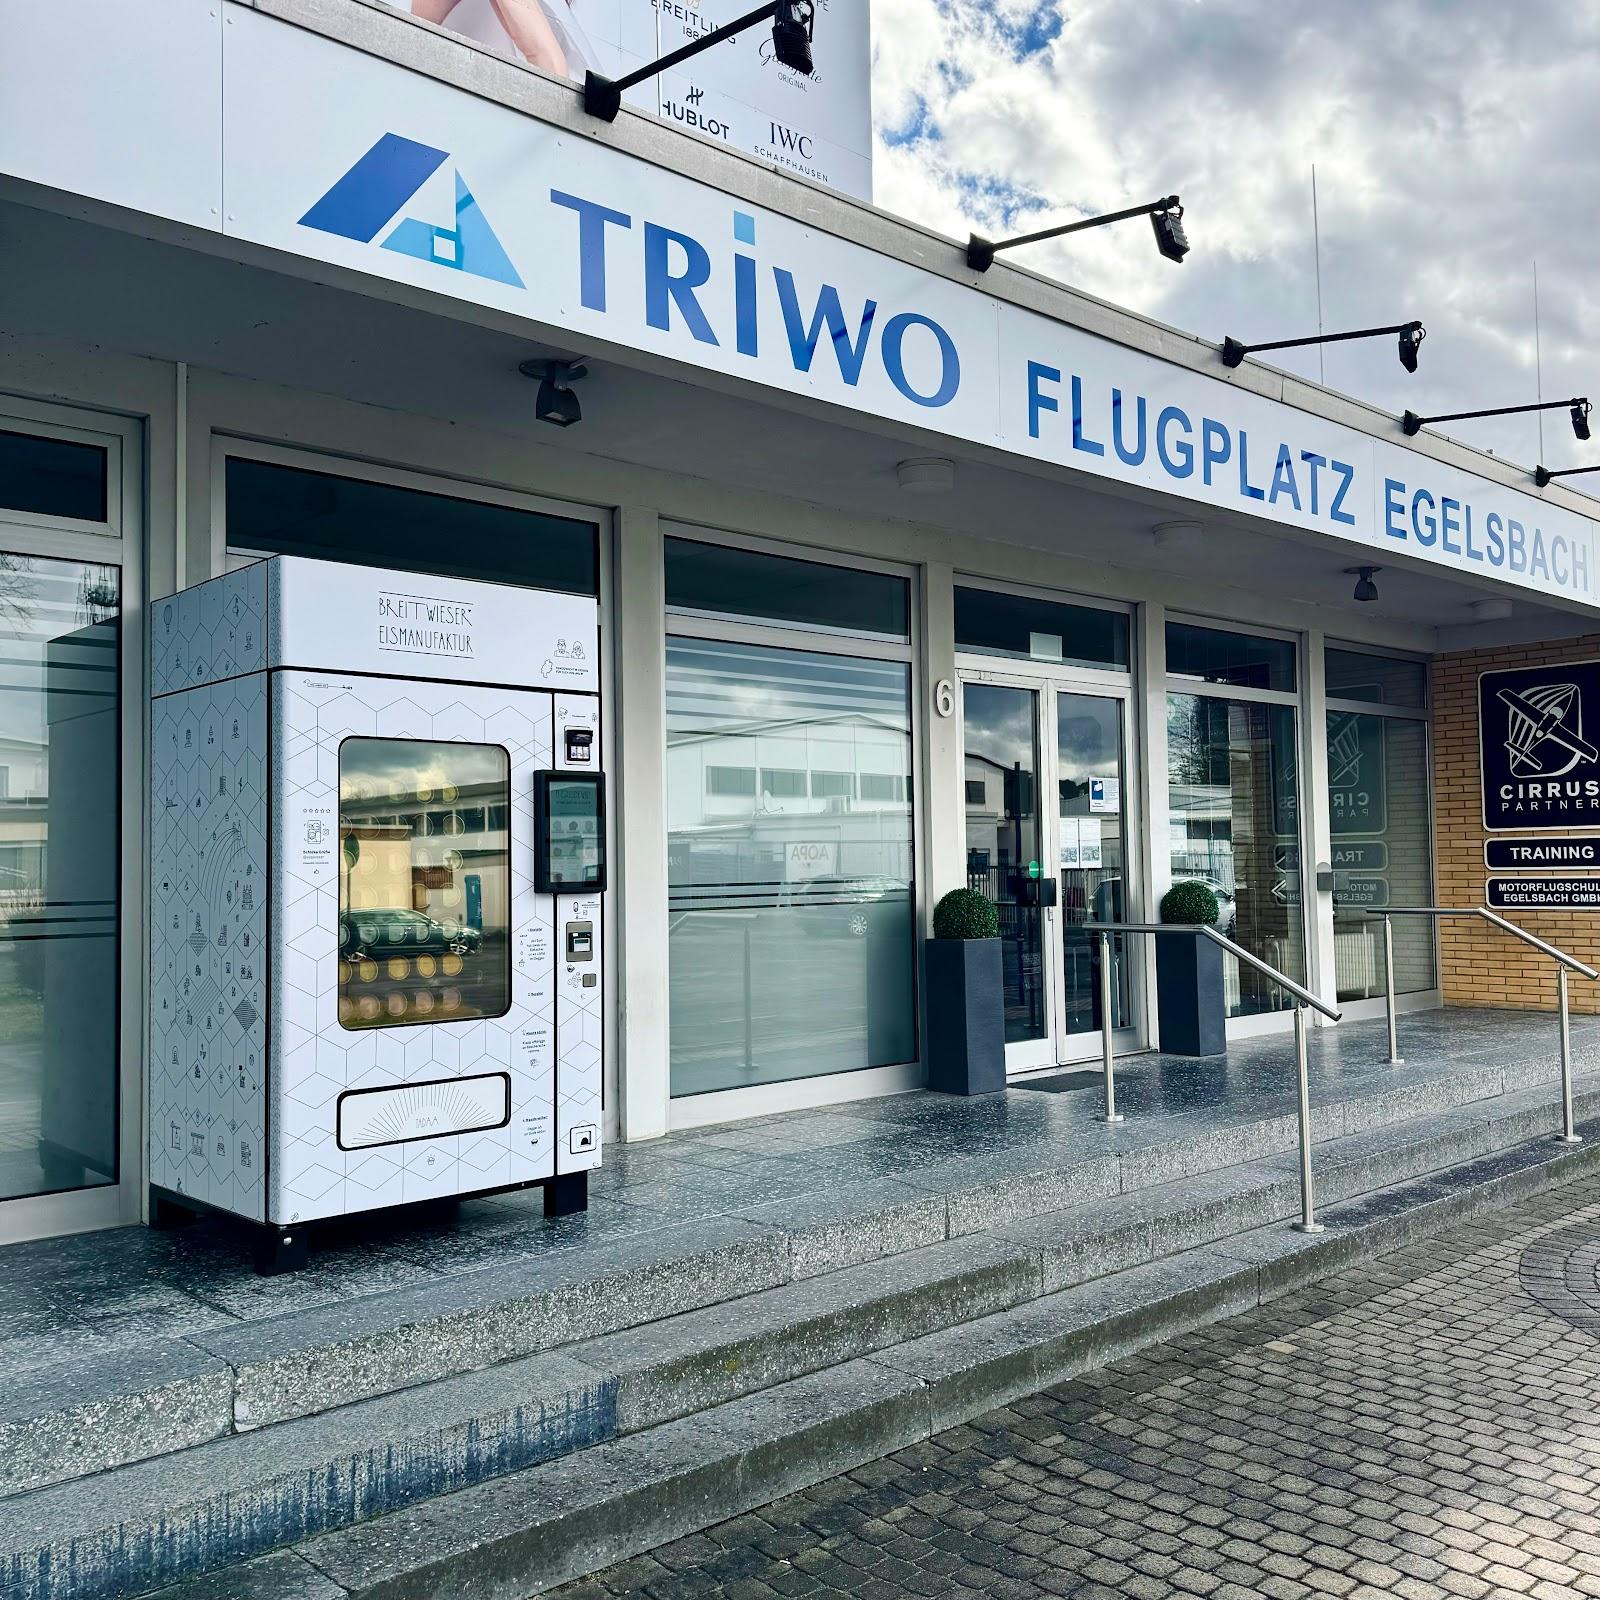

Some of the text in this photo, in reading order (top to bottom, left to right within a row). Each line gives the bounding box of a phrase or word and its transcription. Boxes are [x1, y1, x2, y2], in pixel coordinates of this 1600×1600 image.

[651, 0, 736, 44] REITLIG
[682, 25, 705, 41] 188
[777, 72, 808, 93] ORIGINAL
[663, 100, 730, 139] HUBLOT
[770, 121, 813, 160] IWC
[754, 145, 829, 183] SCHAFFHAUSEN
[1027, 359, 1356, 526] FLUGPLATZ
[1384, 478, 1589, 592] EGELSBACH
[379, 625, 473, 653] EISMANUFAKTUR
[936, 679, 954, 718] 6
[1500, 780, 1600, 800] CIRRUS
[1501, 799, 1600, 812] PARTNER
[1509, 845, 1595, 860] TRAINING
[1503, 893, 1569, 903] EGELSBACH
